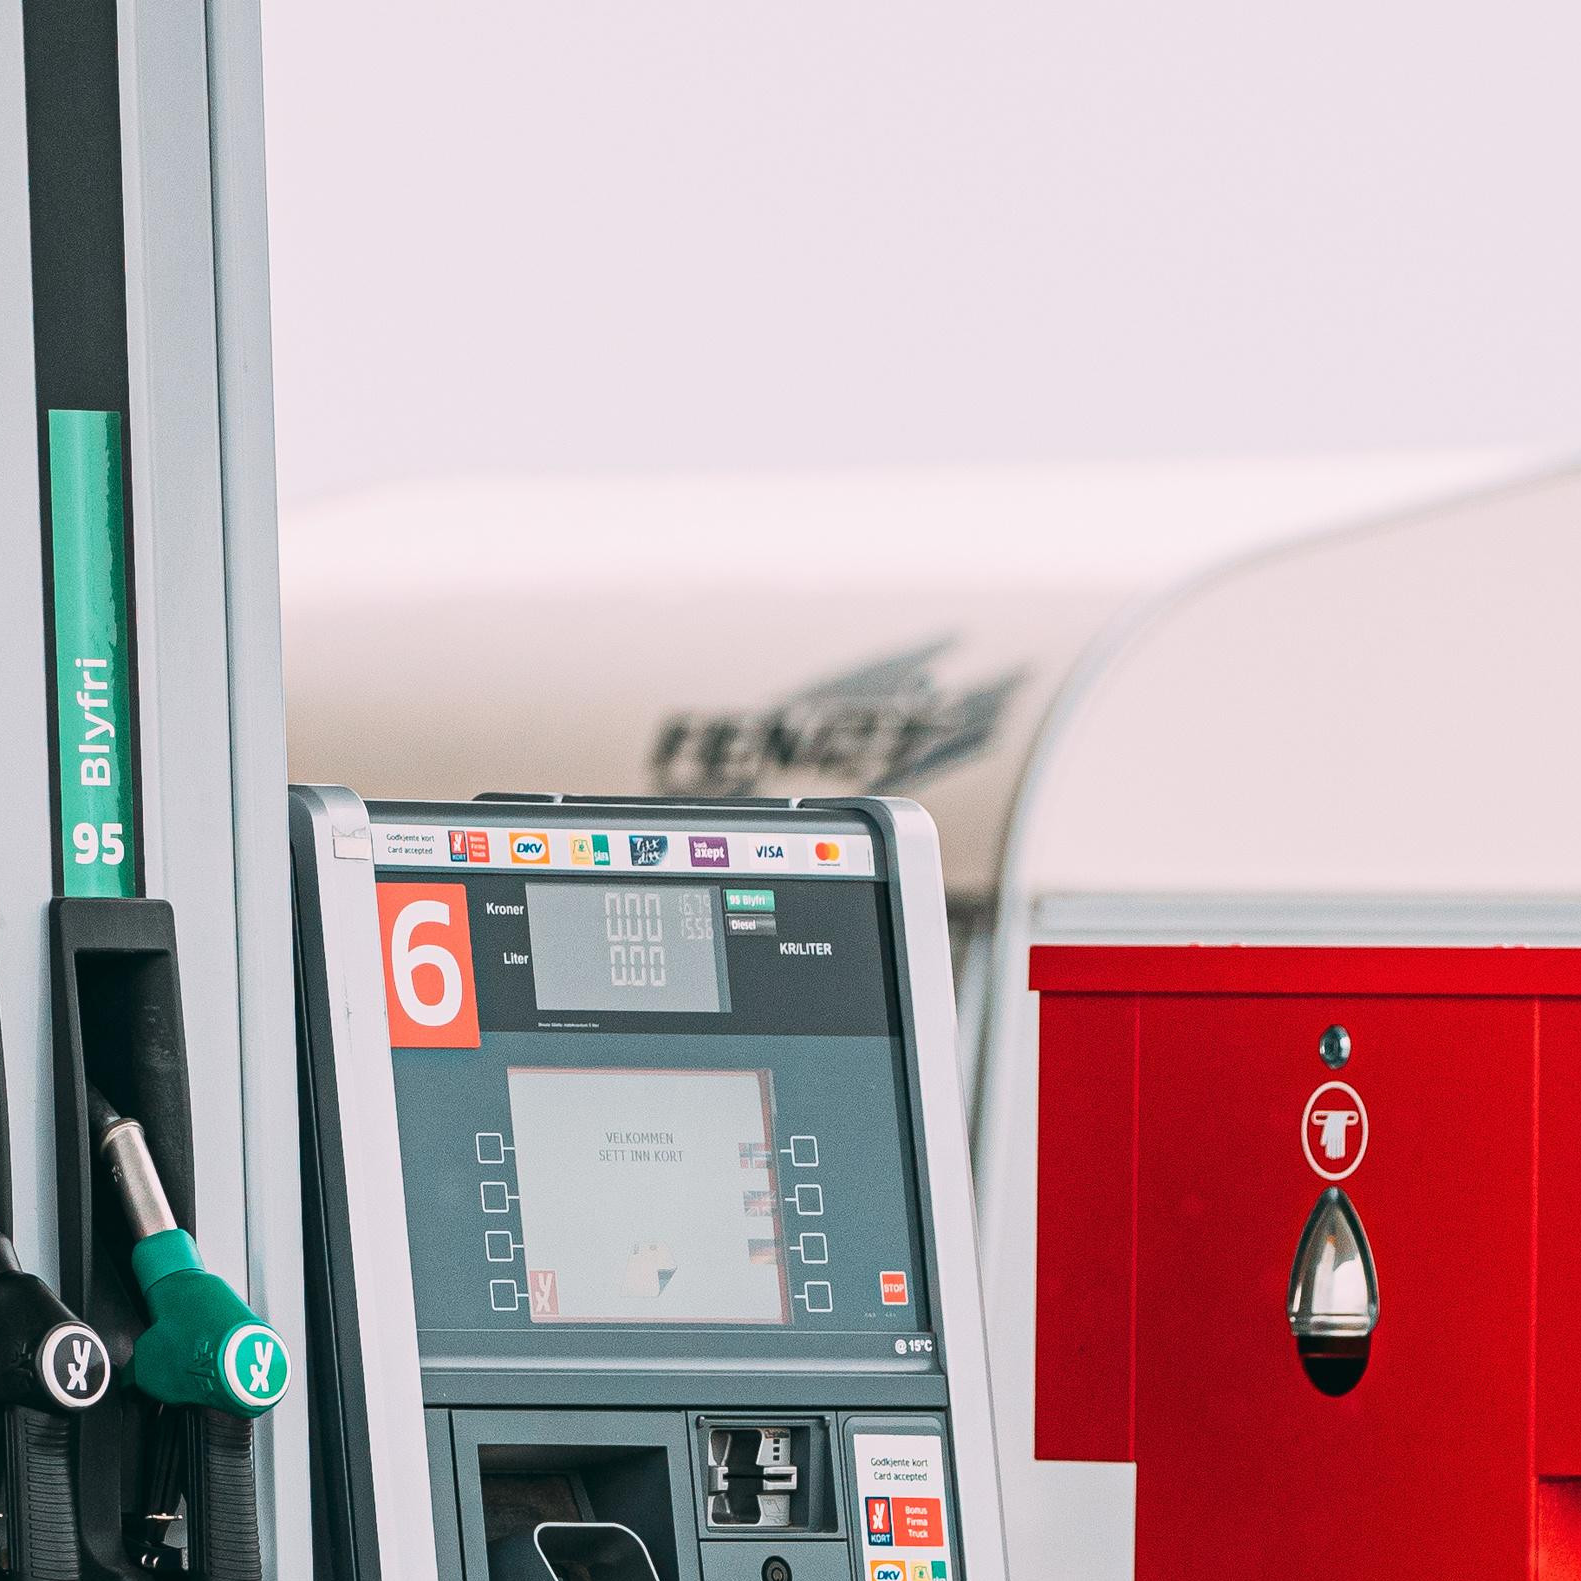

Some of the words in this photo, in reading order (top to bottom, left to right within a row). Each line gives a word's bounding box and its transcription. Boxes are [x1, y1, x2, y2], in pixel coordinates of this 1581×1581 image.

[75, 657, 117, 787] Blyfri
[72, 822, 125, 865] 95
[516, 842, 543, 853] DKV
[694, 846, 725, 862] axept
[755, 845, 784, 858] VISA
[729, 895, 741, 905] 95
[743, 895, 767, 907] Blyfri
[486, 902, 524, 915] Kroner
[731, 919, 757, 930] Diesel
[779, 942, 832, 956] KR/LITER
[391, 900, 463, 1027] 6
[503, 952, 529, 965] Liter
[605, 1132, 674, 1144] VELKOMMEN
[599, 1149, 626, 1161] SETT
[630, 1150, 650, 1161] INN
[654, 1150, 684, 1162] KORT
[883, 1283, 905, 1293] STOP
[870, 1457, 910, 1467] Godkjente
[912, 1458, 928, 1467] kort
[873, 1472, 891, 1480] Card
[893, 1472, 928, 1481] accepted
[905, 1505, 928, 1515] Bonus
[906, 1517, 928, 1526] Firma
[870, 1534, 891, 1543] KORT
[908, 1529, 929, 1538] Truck
[877, 1570, 901, 1580] DKV
